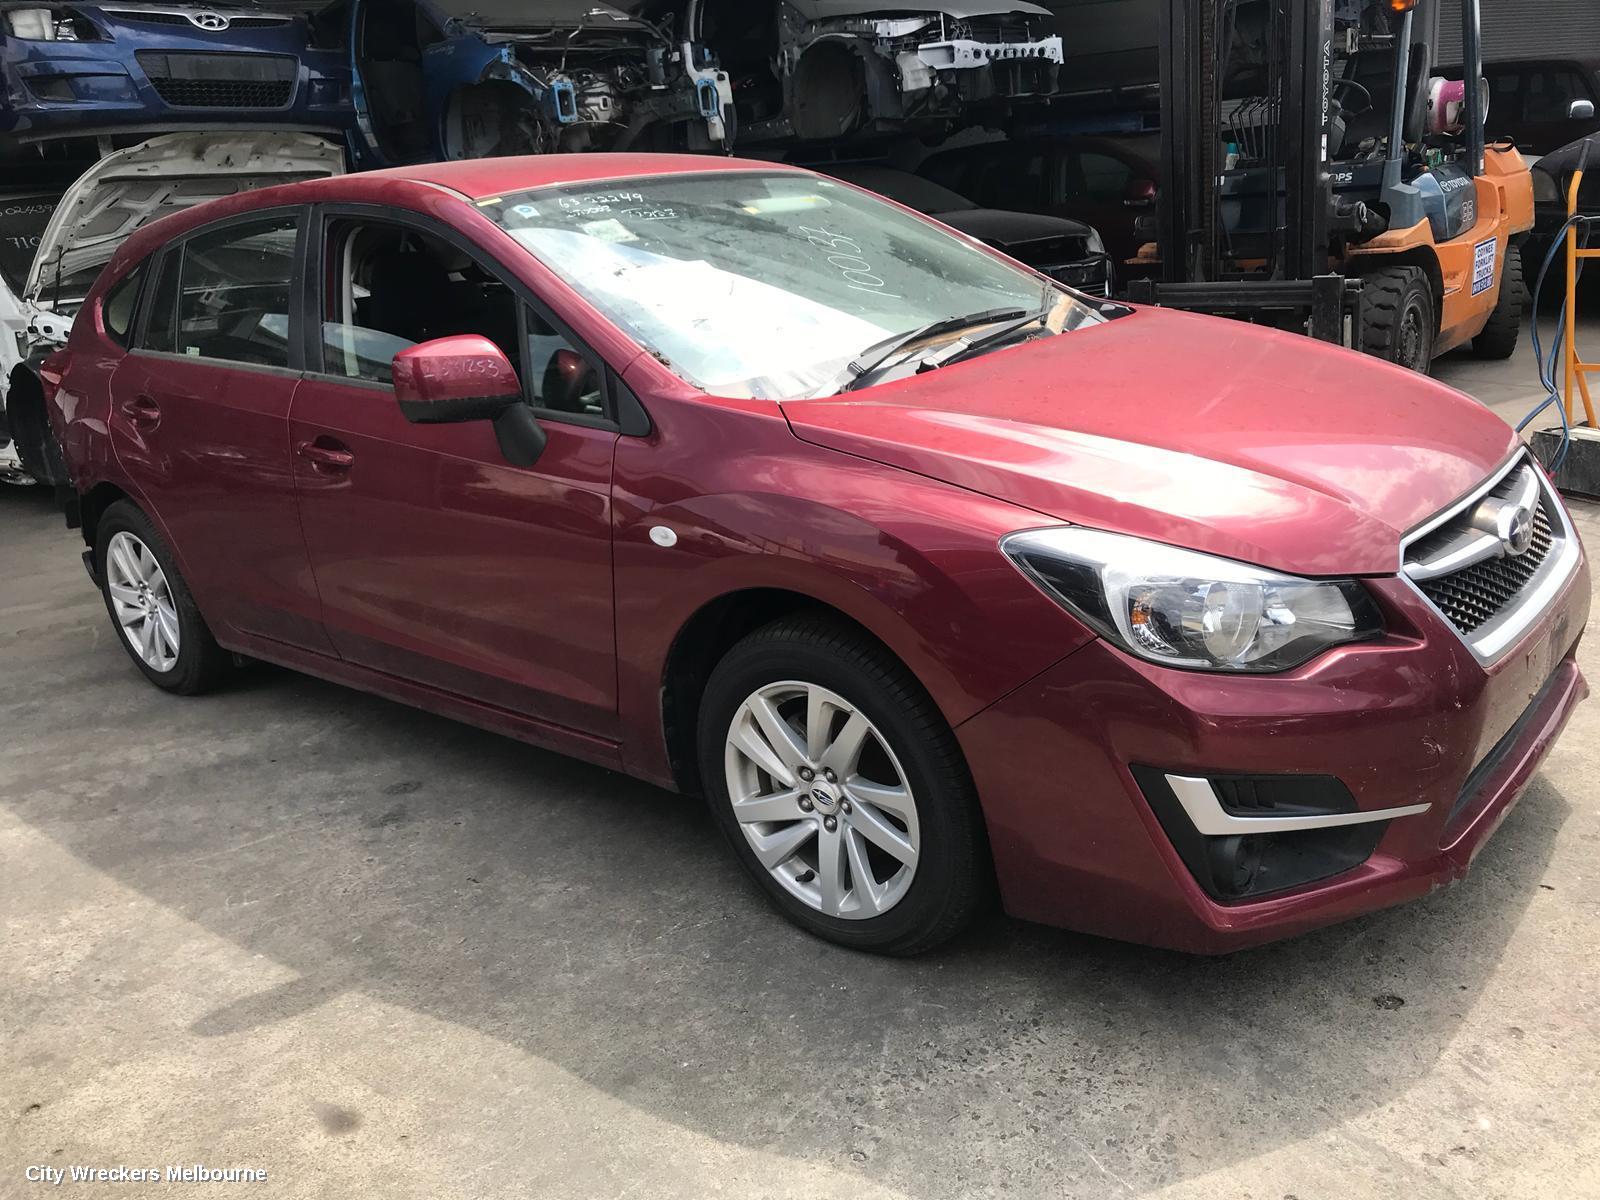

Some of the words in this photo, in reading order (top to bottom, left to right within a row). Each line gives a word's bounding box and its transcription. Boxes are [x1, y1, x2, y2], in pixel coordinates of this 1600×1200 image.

[1321, 40, 1330, 126] TOYOTA
[1448, 177, 1471, 190] TOYOTA
[1475, 254, 1494, 270] FORKLIFT
[1476, 266, 1492, 279] TRUCKS
